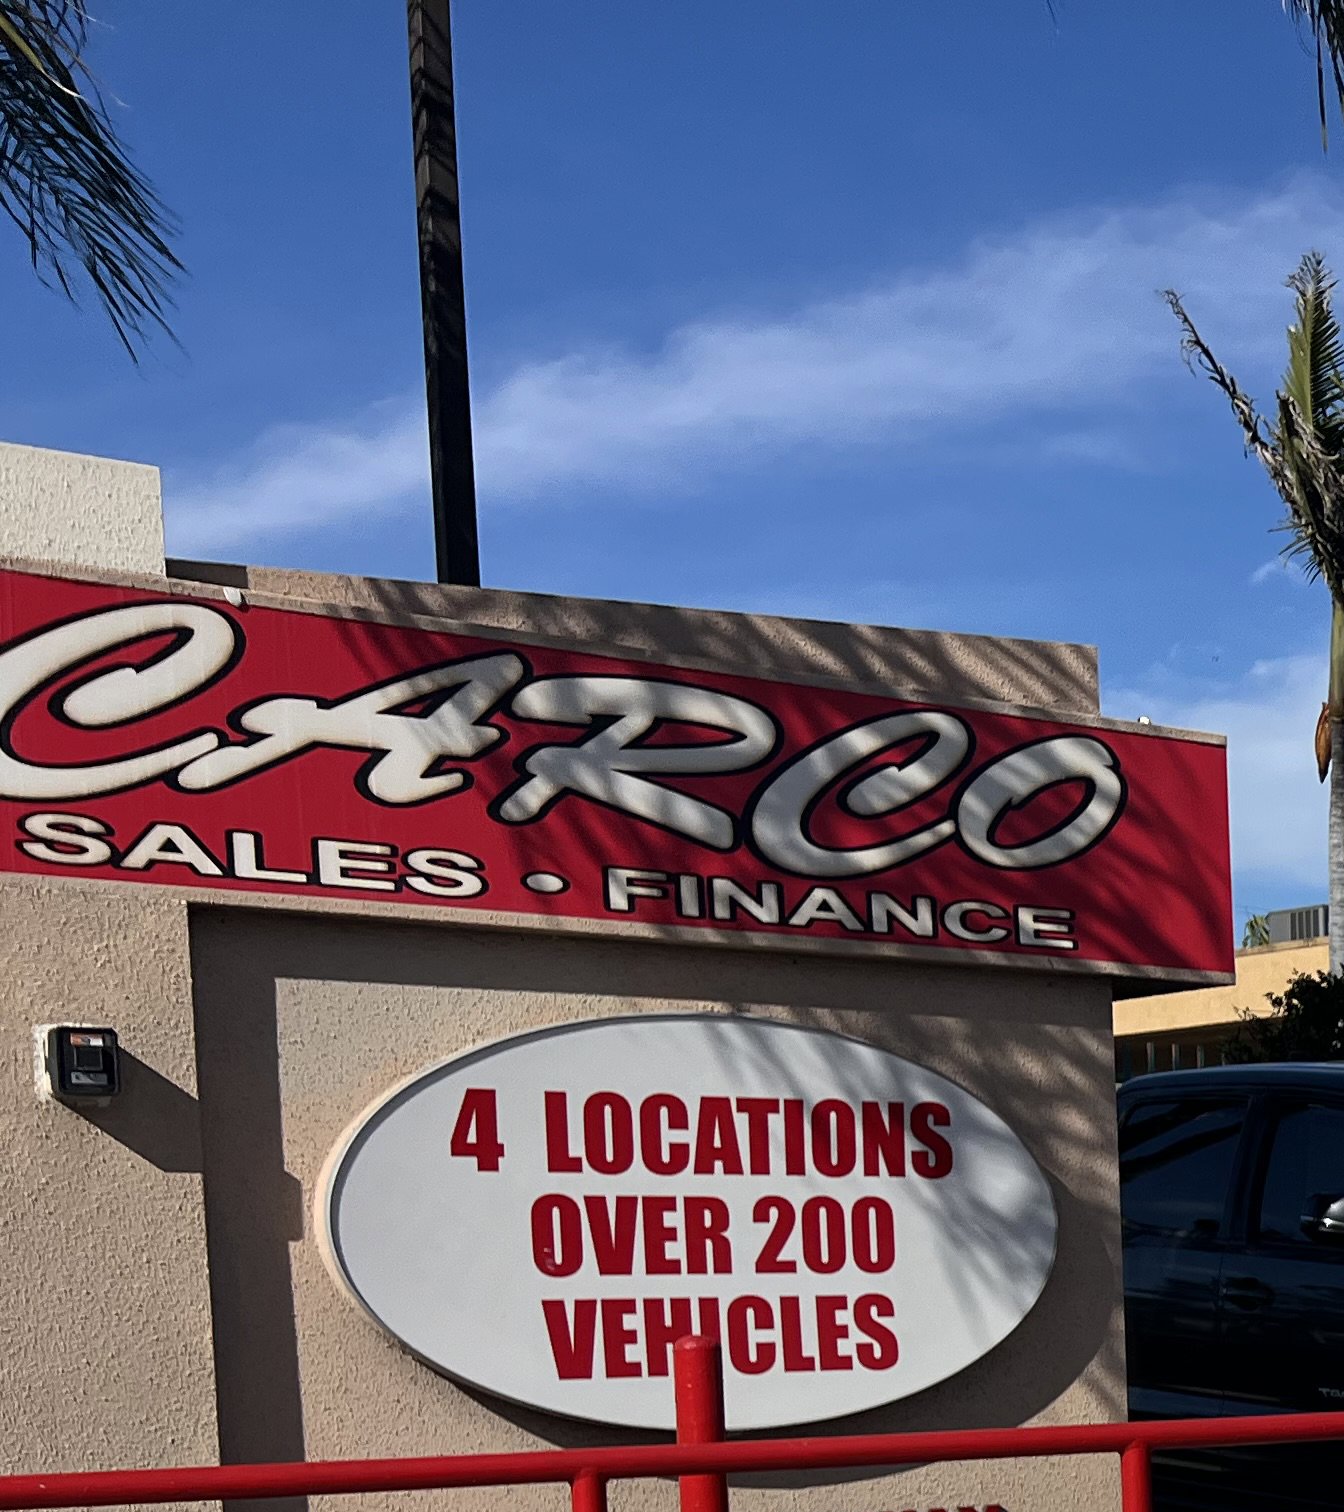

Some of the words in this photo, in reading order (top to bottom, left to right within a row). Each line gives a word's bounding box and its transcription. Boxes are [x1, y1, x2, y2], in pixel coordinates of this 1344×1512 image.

[0, 600, 1127, 878] CARCO
[16, 812, 488, 898] SALES
[602, 865, 1080, 950] FINANCE
[450, 1088, 504, 1172] 4
[544, 1090, 954, 1180] LOCATIONS
[531, 1193, 732, 1278] OVER
[752, 1194, 896, 1275] 200
